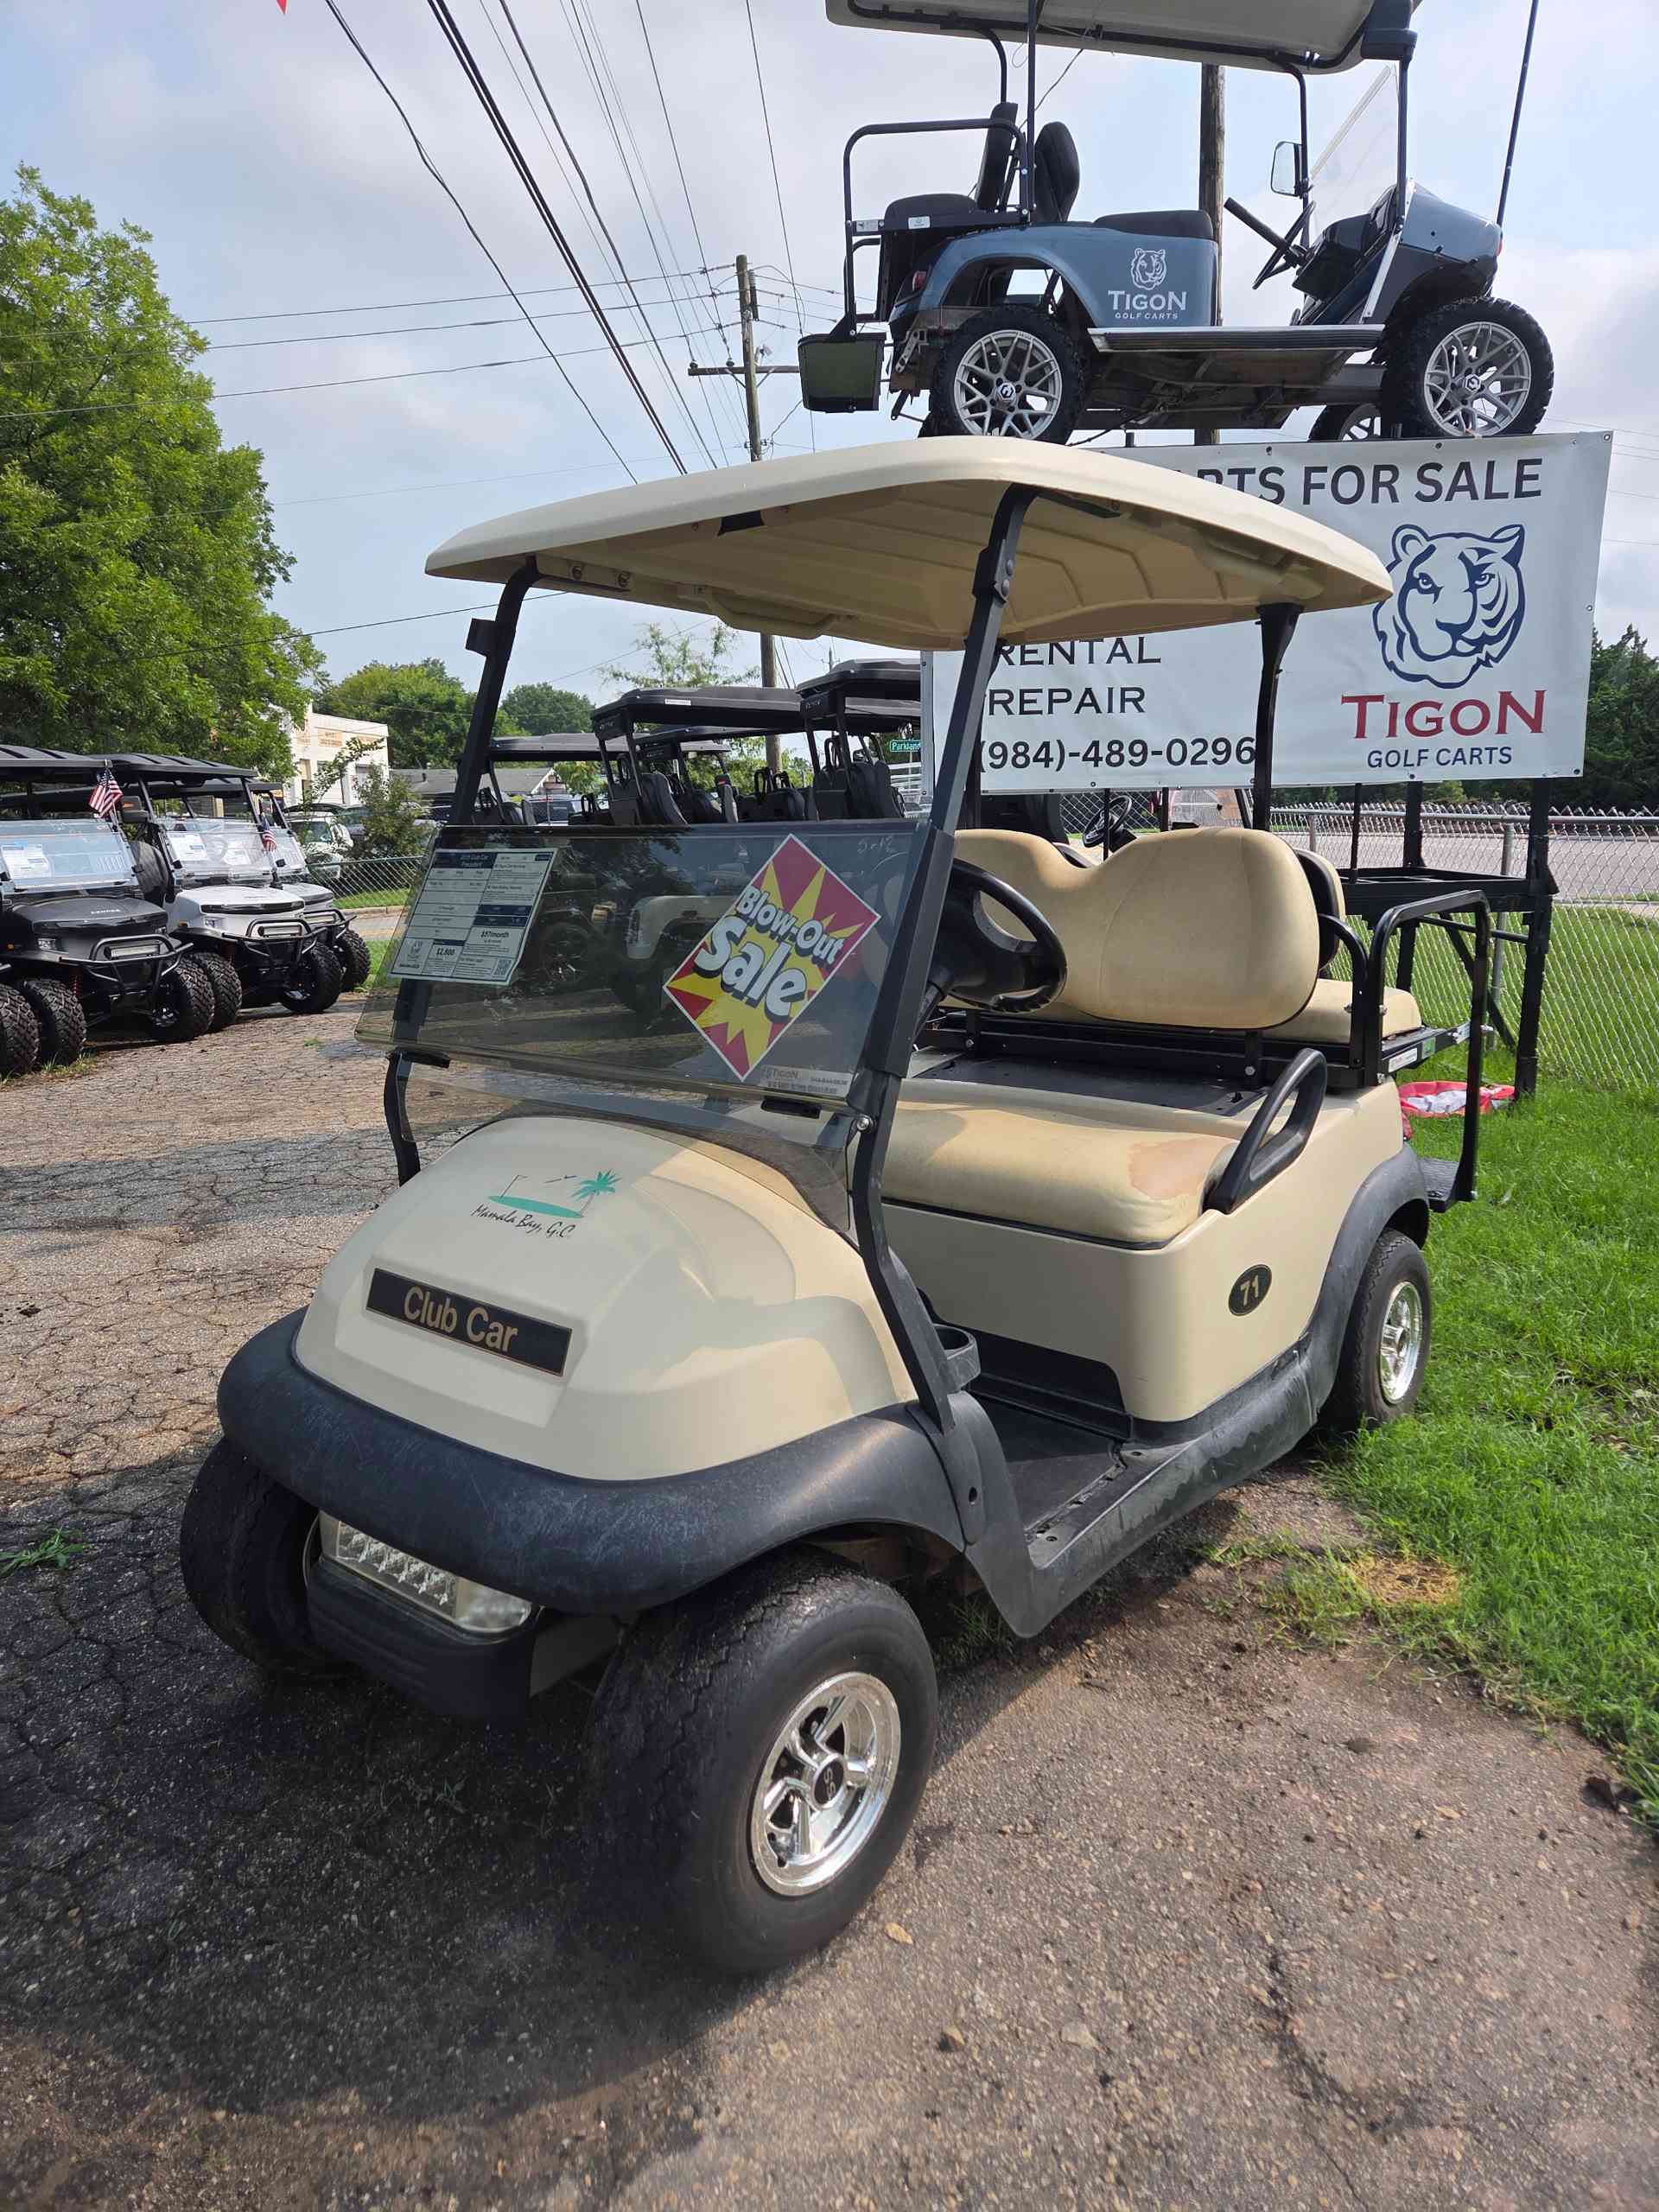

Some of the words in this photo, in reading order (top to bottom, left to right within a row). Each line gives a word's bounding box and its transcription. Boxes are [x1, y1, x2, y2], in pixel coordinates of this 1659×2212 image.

[1108, 289, 1187, 311] TIGON
[1302, 464, 1400, 505] FOR
[1414, 457, 1543, 503] SALE
[998, 636, 1161, 666] RENTAL
[988, 686, 1146, 715] REPAIR
[1341, 690, 1547, 739] TIGON
[980, 736, 1255, 772] (984)-489-0296
[1367, 748, 1429, 768] GOLF
[1435, 746, 1513, 766] CARTS
[736, 885, 845, 967] Blow-Out
[693, 914, 807, 1020] Sale
[1240, 1274, 1259, 1306] 71
[404, 1286, 458, 1333] Club
[467, 1307, 518, 1352] Car
